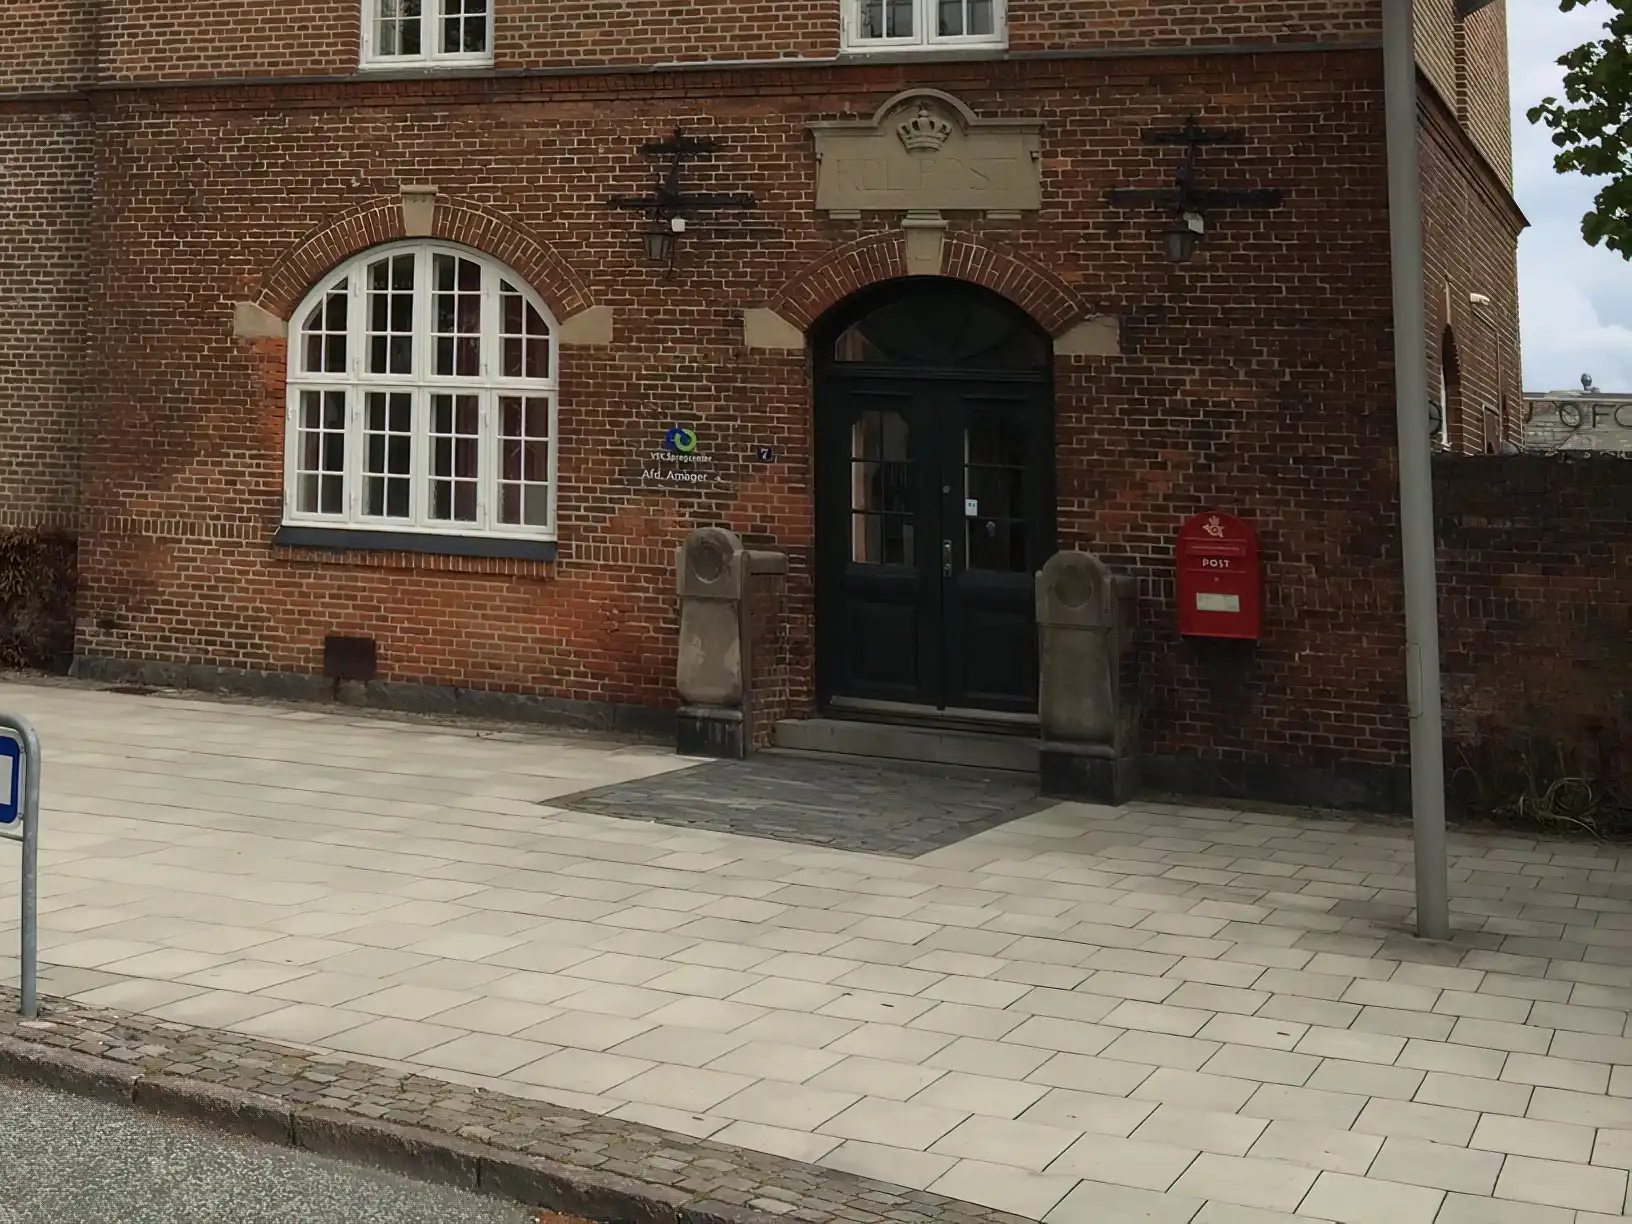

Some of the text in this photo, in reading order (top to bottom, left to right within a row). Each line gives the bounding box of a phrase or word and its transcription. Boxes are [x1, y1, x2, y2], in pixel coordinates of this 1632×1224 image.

[760, 448, 769, 459] 7
[642, 469, 708, 483] Afd. Amager
[1202, 558, 1230, 568] POST
